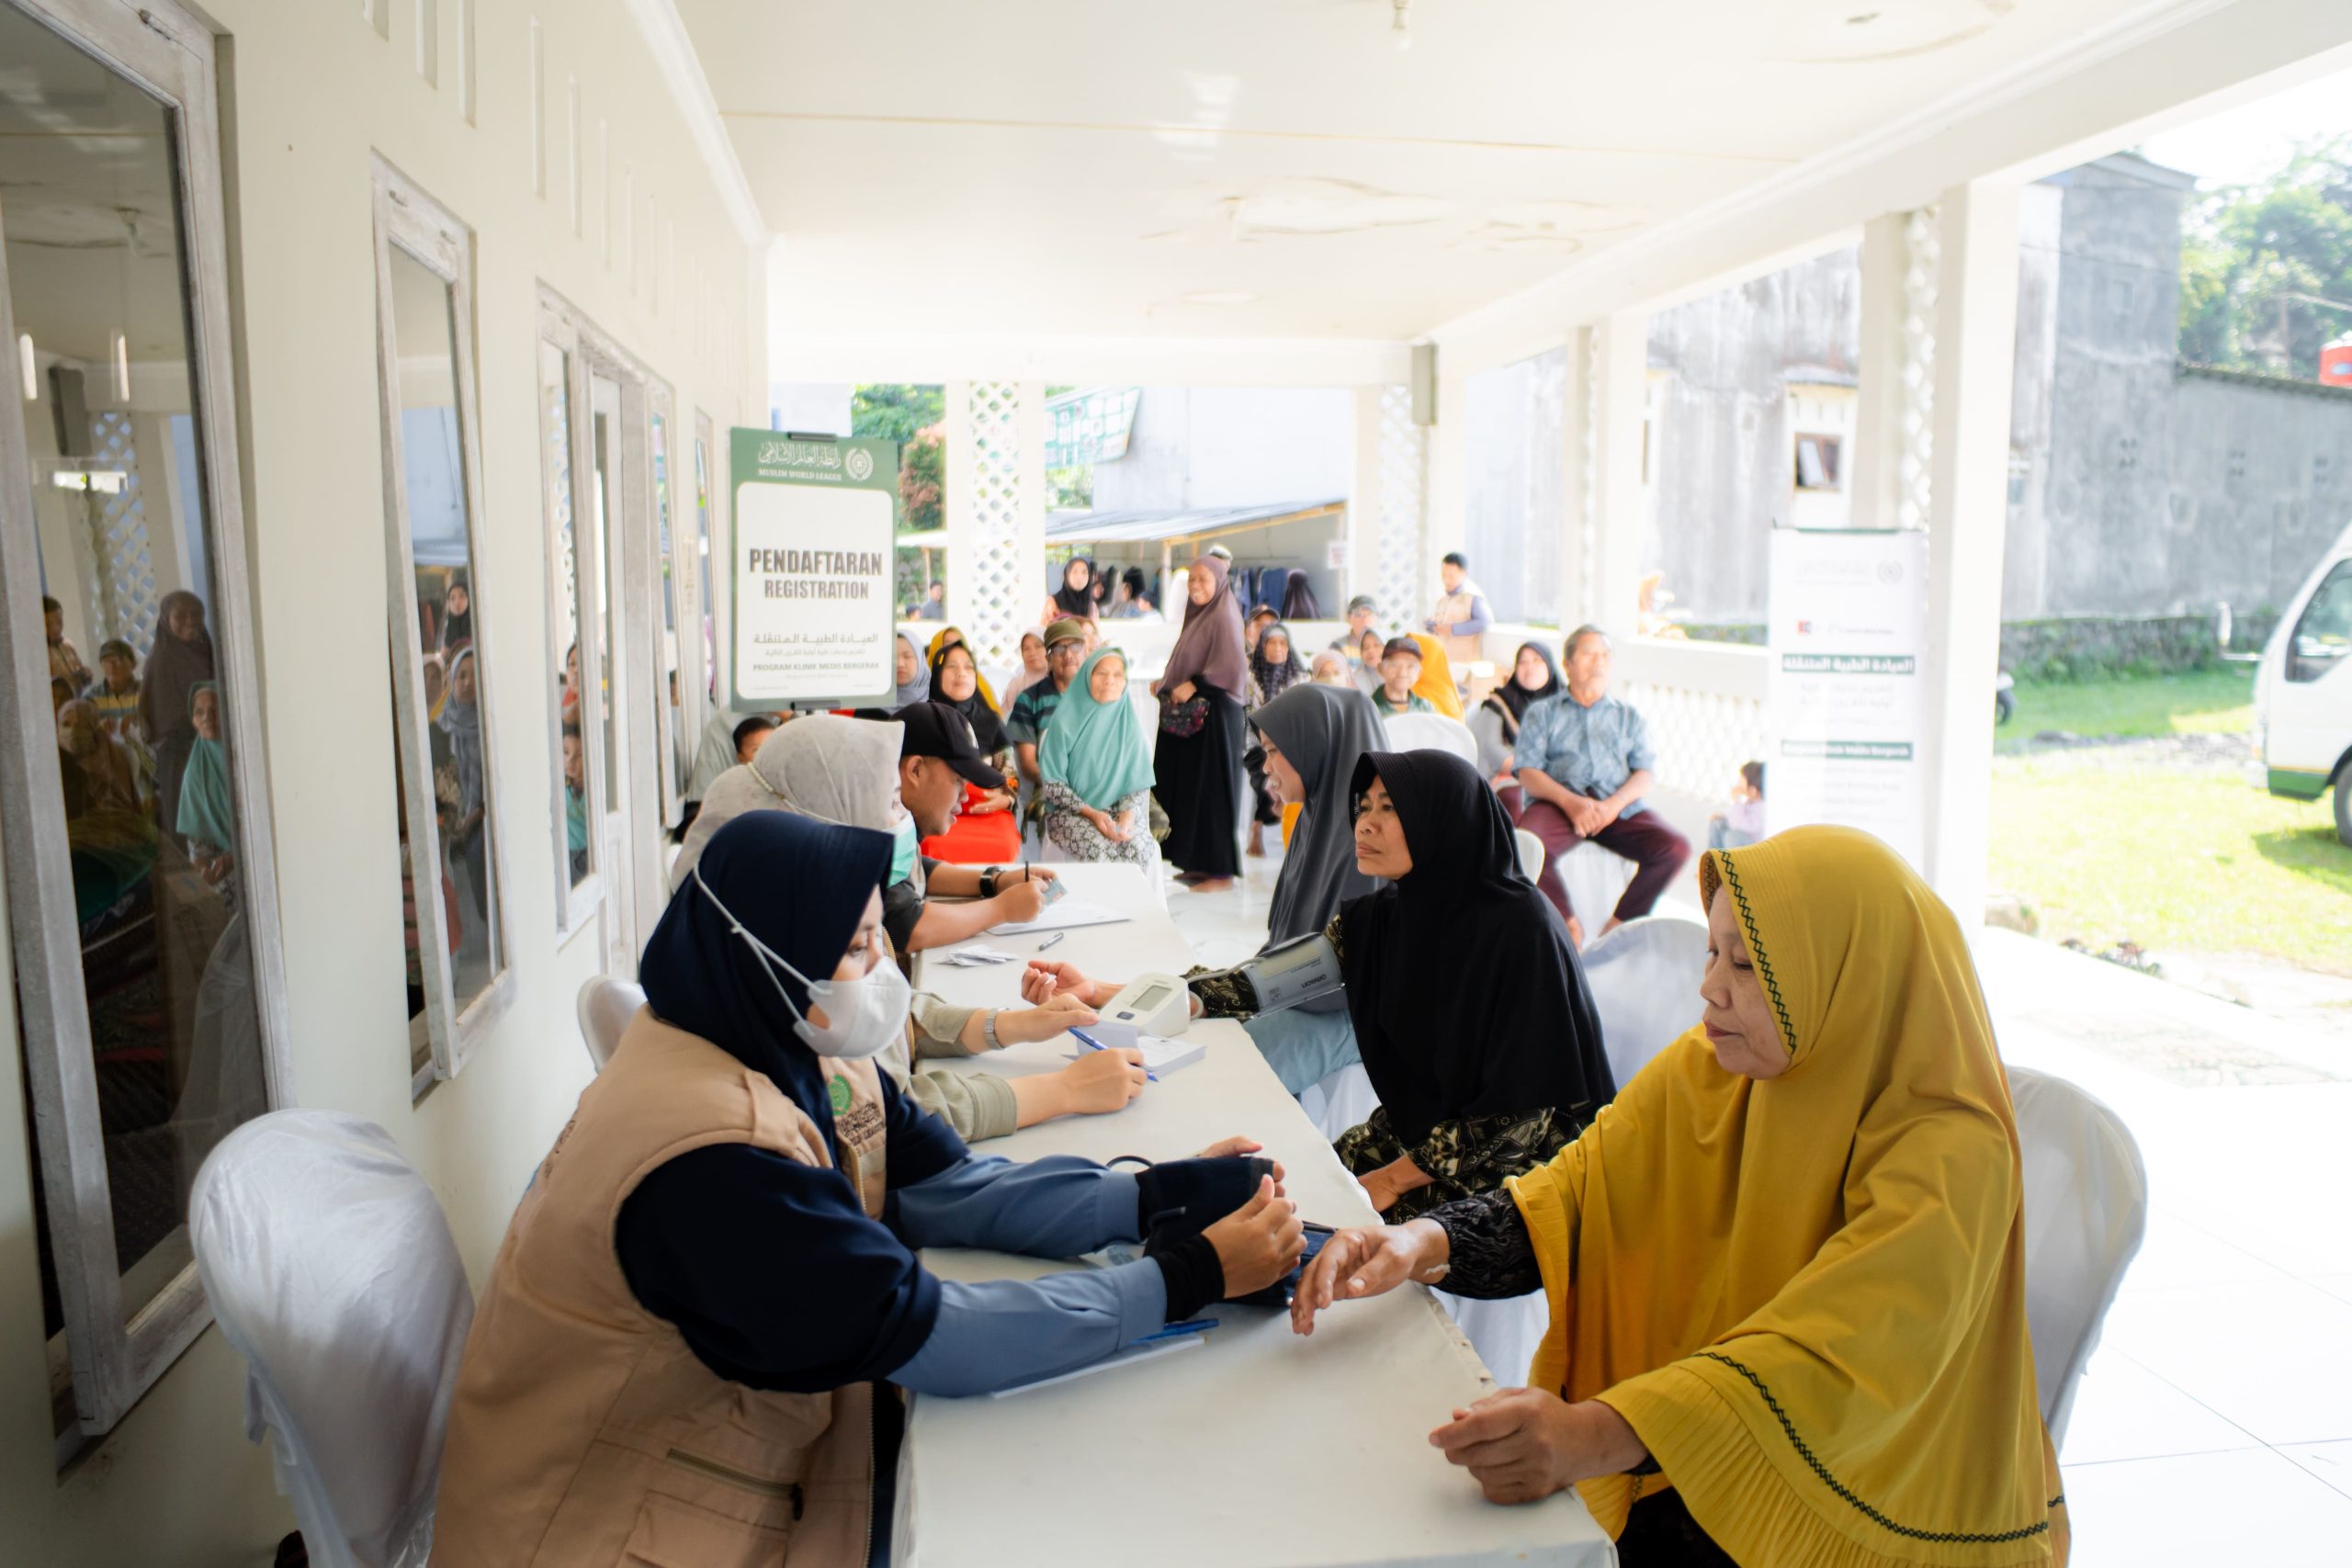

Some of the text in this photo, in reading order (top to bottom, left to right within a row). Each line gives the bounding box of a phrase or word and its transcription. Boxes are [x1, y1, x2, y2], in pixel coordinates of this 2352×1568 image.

[758, 468, 842, 481] MUSLIM WORLD LEAGUE
[749, 548, 883, 576] PENDAFTARAN
[764, 579, 869, 600] REGISTRATION
[752, 660, 880, 671] PROGRAM KLINIK MEDIS BERGERAK
